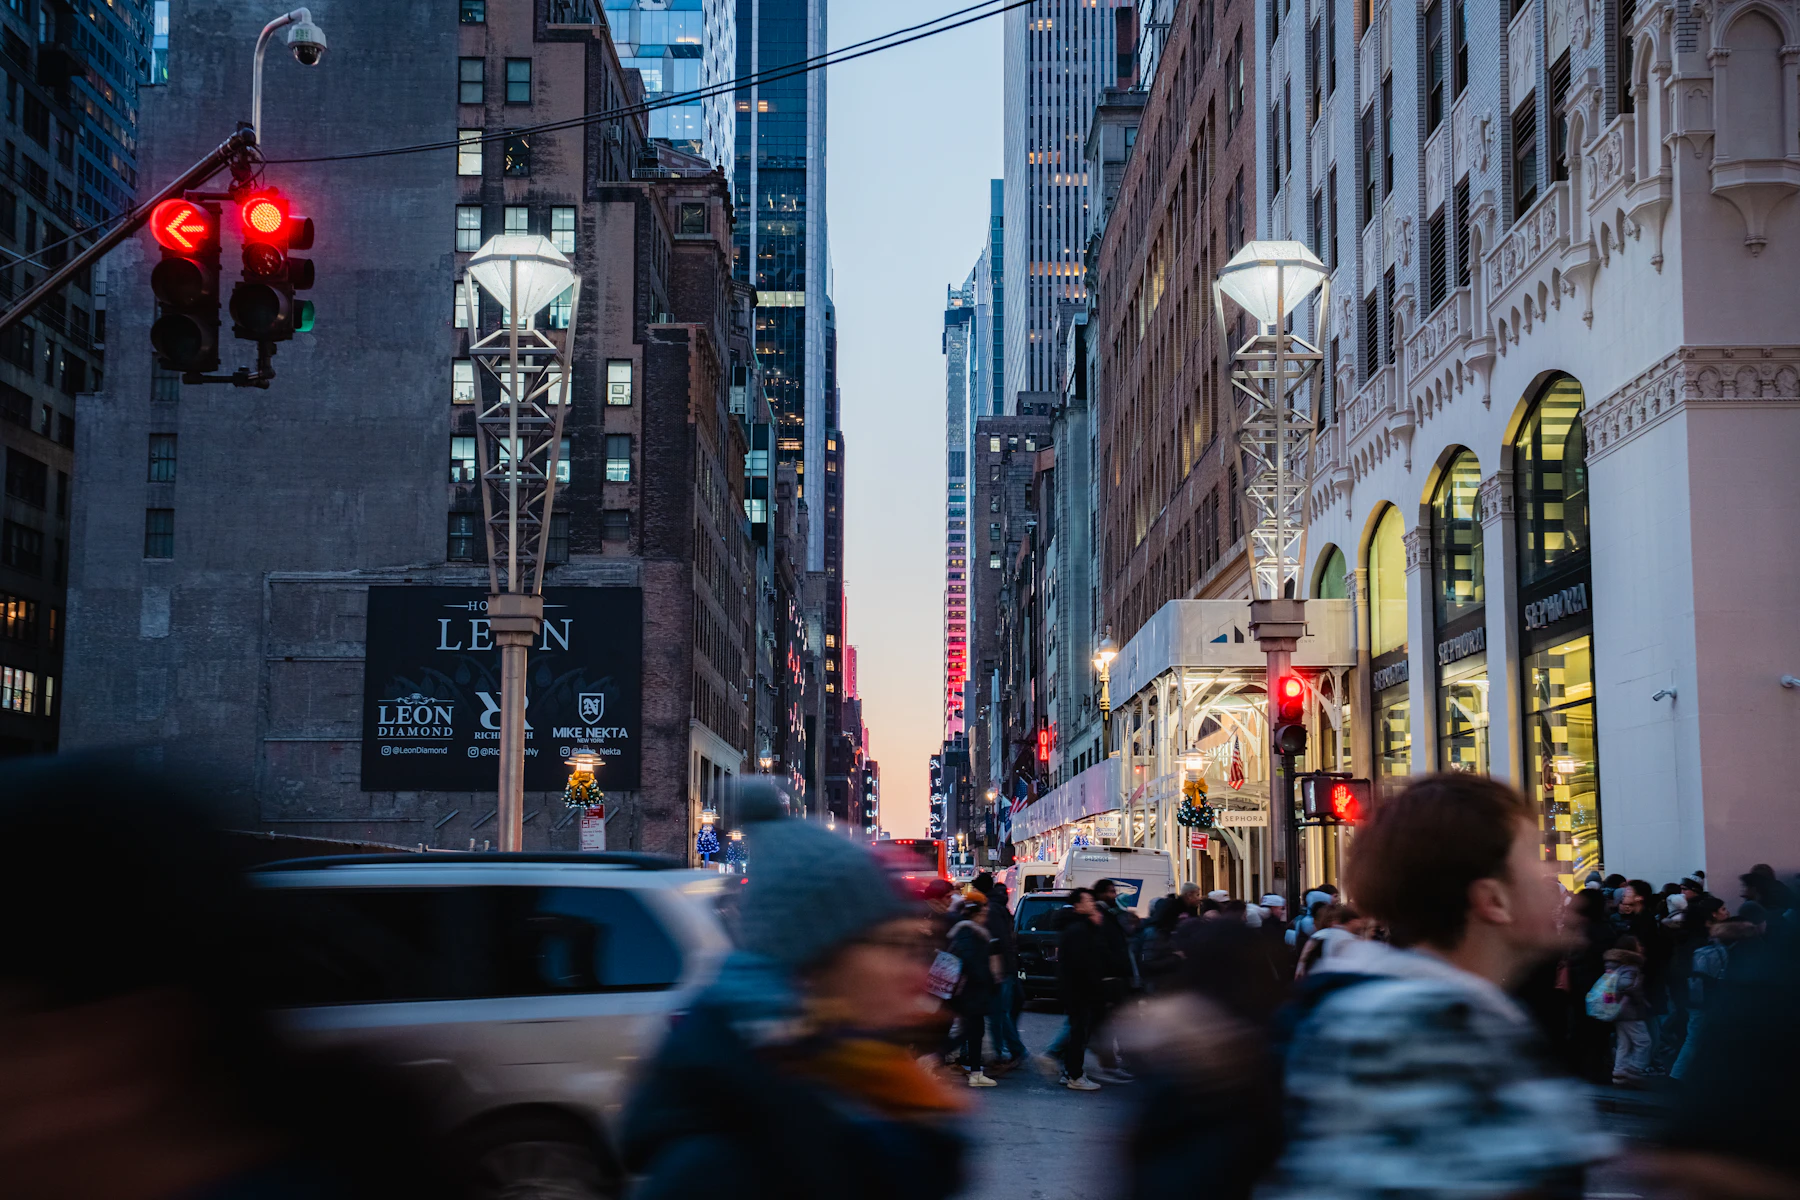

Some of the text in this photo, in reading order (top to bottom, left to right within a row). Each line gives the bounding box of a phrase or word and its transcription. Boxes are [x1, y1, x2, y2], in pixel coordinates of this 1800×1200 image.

[1524, 582, 1588, 631] SEPHORA
[436, 618, 574, 651] LEN
[1438, 626, 1486, 666] SEPHORA
[377, 705, 454, 725] LEON
[377, 727, 454, 737] DIAMOND
[552, 727, 629, 739] MIKE NEKTA
[392, 746, 448, 755] @LeonDiamond
